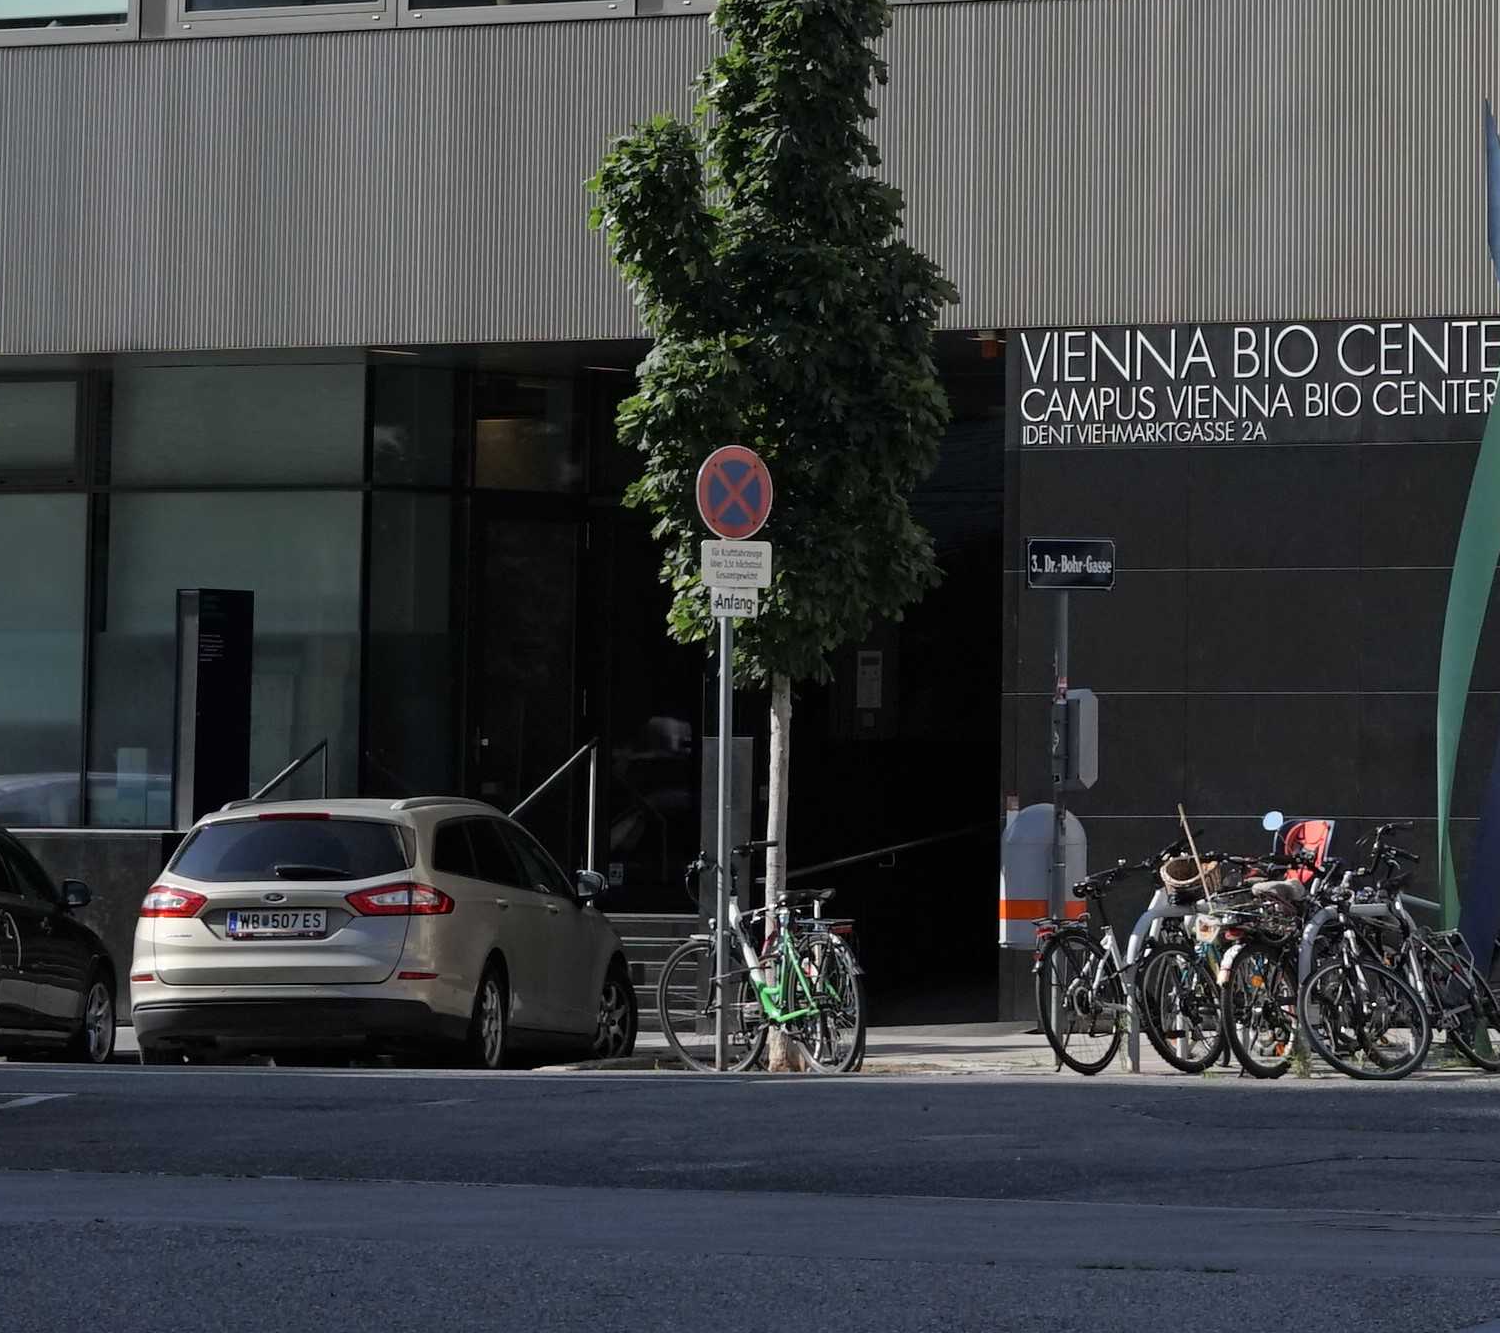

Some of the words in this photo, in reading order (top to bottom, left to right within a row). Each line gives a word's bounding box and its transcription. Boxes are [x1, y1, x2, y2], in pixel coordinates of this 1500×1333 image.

[1021, 329, 1215, 382] VIENNA
[1233, 325, 1318, 379] BIO
[1020, 386, 1155, 422] CAMPUS
[1166, 384, 1294, 420] VIENNA
[1304, 381, 1362, 417] BIO
[1372, 378, 1498, 416] CENTER
[1022, 424, 1074, 445] IDENT
[1075, 421, 1235, 444] VIEHMARKTGASSE
[1241, 421, 1268, 441] 2A
[1044, 555, 1112, 574] Dr.-Bohr-Gasse
[715, 594, 753, 614] Anfang
[240, 913, 260, 929] WB
[271, 913, 301, 929] 507
[303, 913, 321, 928] ES
